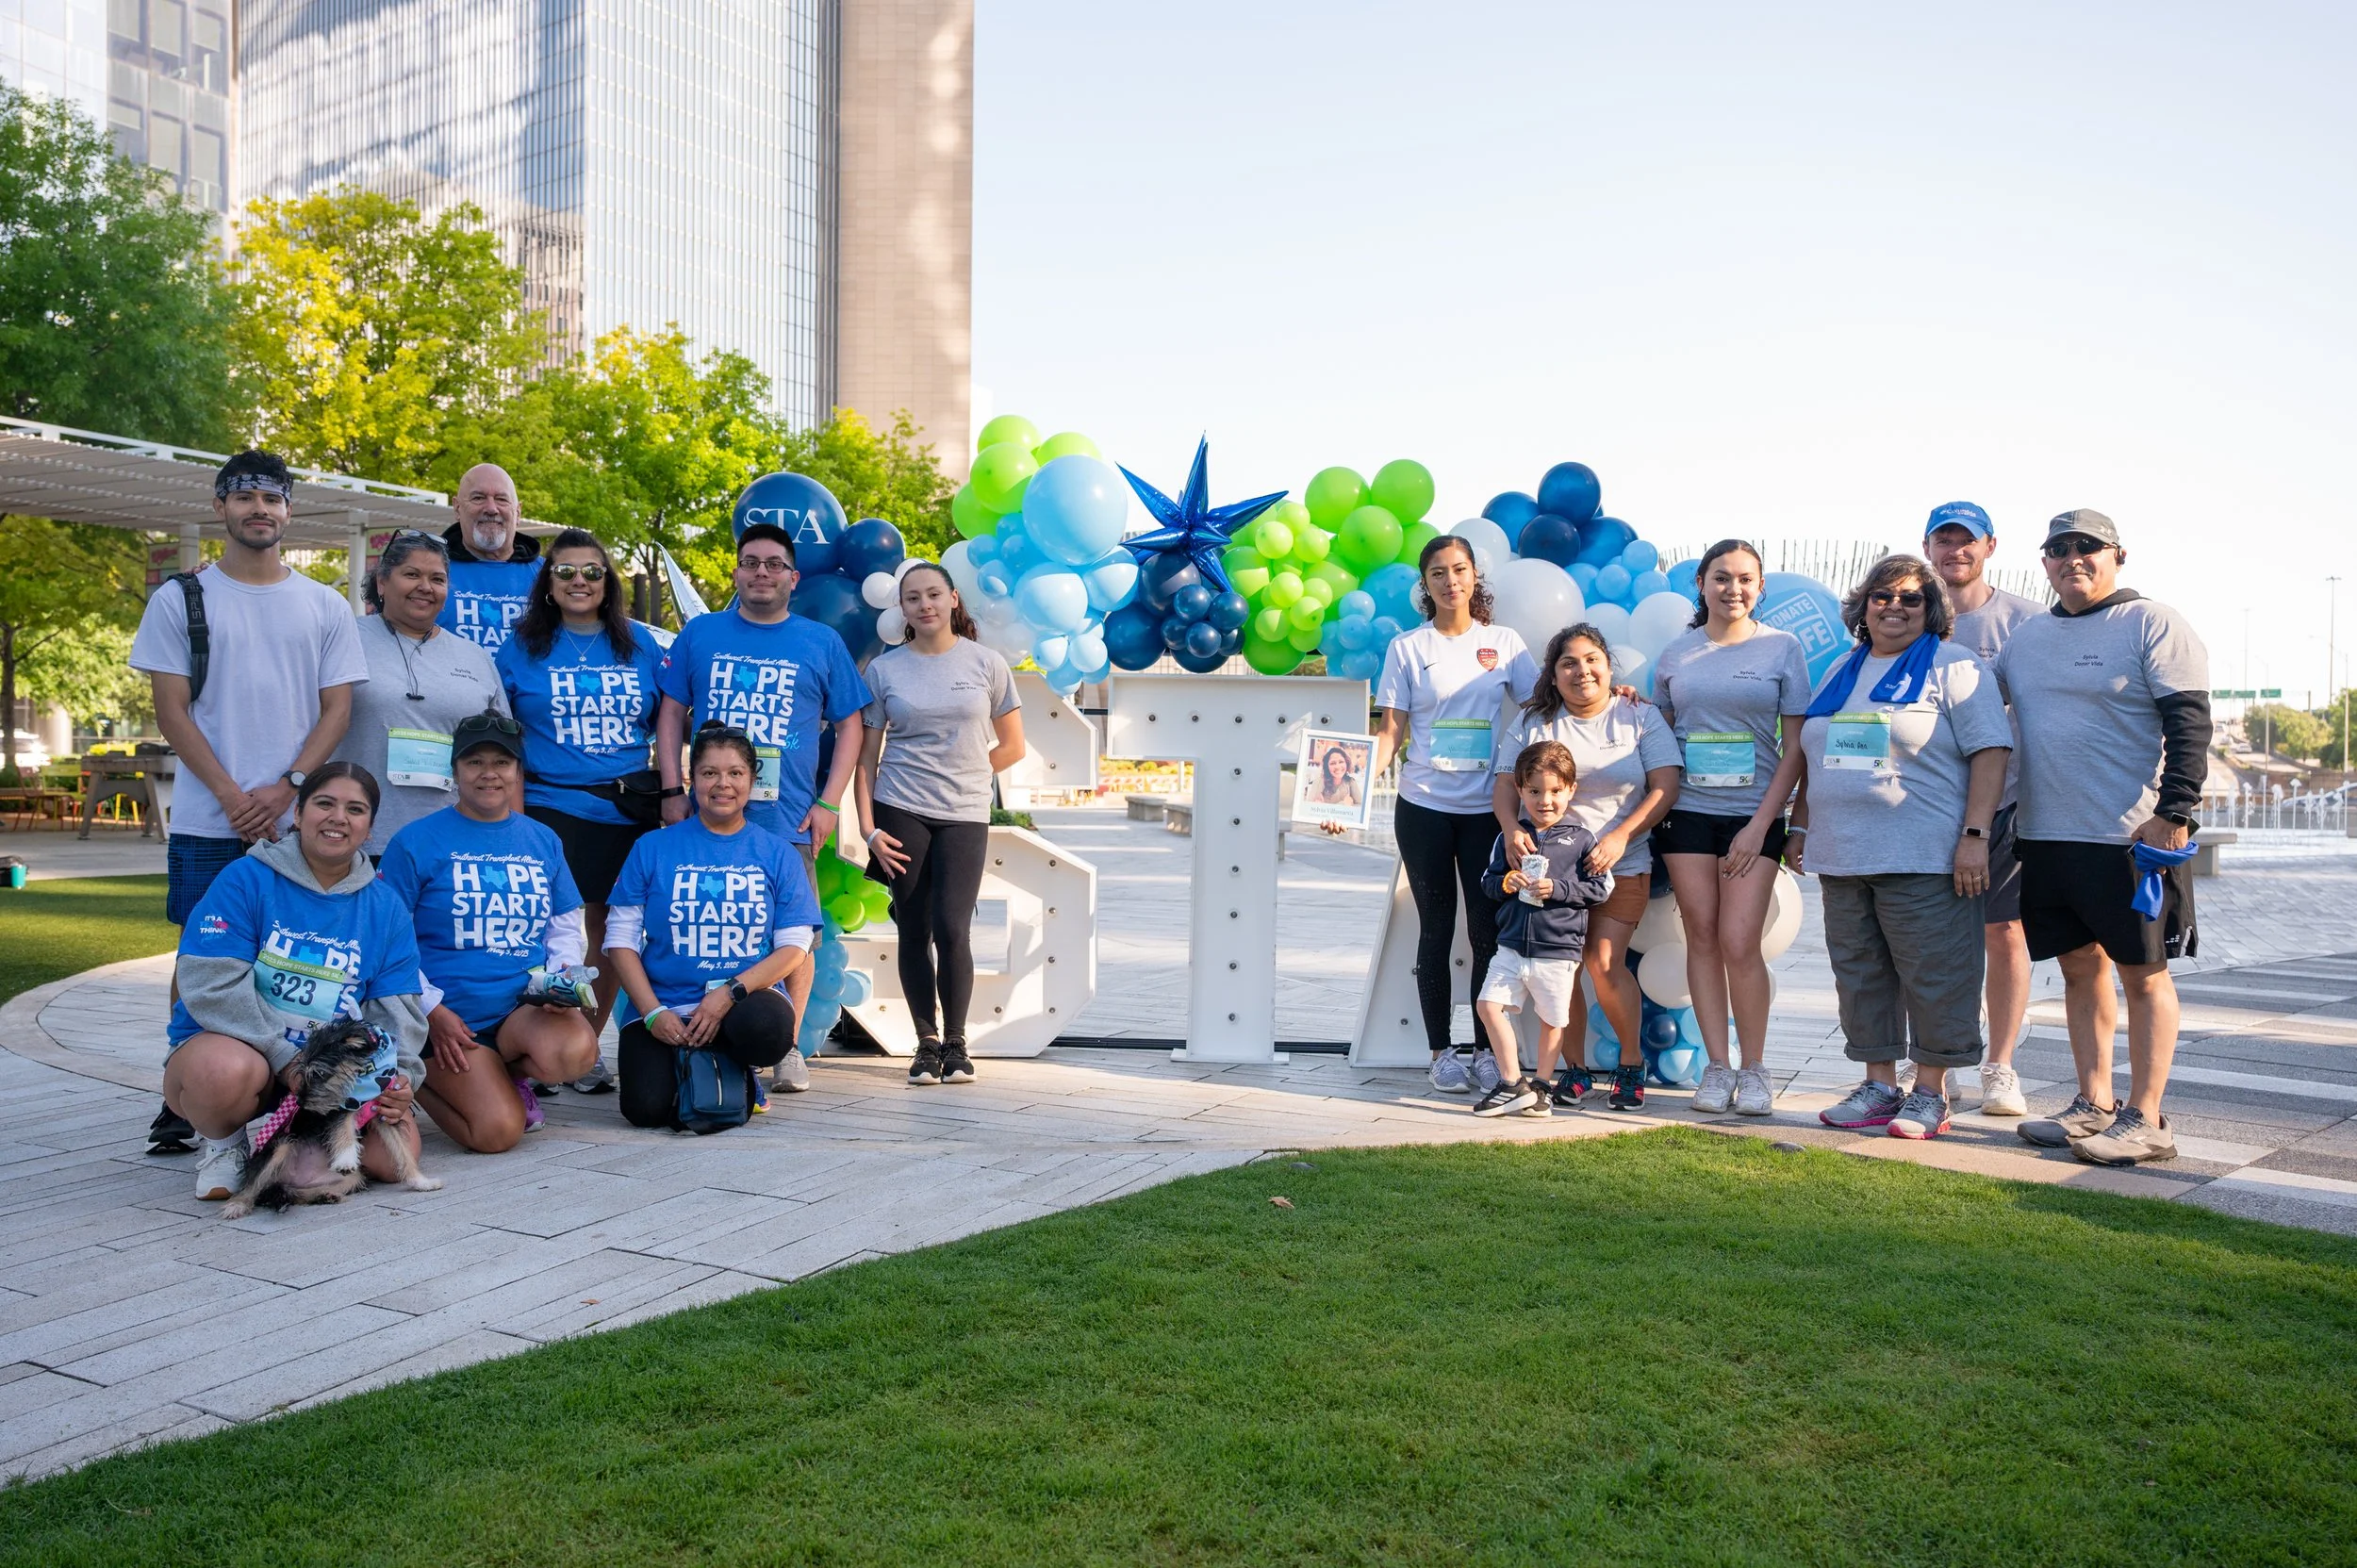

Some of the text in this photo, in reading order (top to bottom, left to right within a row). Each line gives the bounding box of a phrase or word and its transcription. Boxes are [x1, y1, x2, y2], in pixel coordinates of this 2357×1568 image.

[743, 507, 830, 544] STA
[1798, 620, 1831, 653] FE
[712, 652, 800, 669] Southwest Transplant Alliance
[551, 695, 643, 717] STARTS
[707, 688, 795, 718] STARTS
[553, 716, 638, 746] HERE
[1739, 775, 1748, 784] 5K
[451, 851, 485, 862] Southwest
[486, 853, 521, 864] Transplant
[675, 864, 707, 873] Southwest
[707, 865, 741, 874] Transplant
[451, 892, 551, 918] STARTS
[668, 900, 767, 925] STARTS
[453, 916, 547, 950] HERE
[671, 925, 766, 958] HERE
[486, 948, 505, 958] May
[513, 949, 530, 958] 2025
[698, 960, 716, 971] May
[724, 961, 741, 969] 2025
[294, 964, 316, 975] STARTS
[316, 968, 330, 977] HERE
[271, 972, 317, 1006] 323
